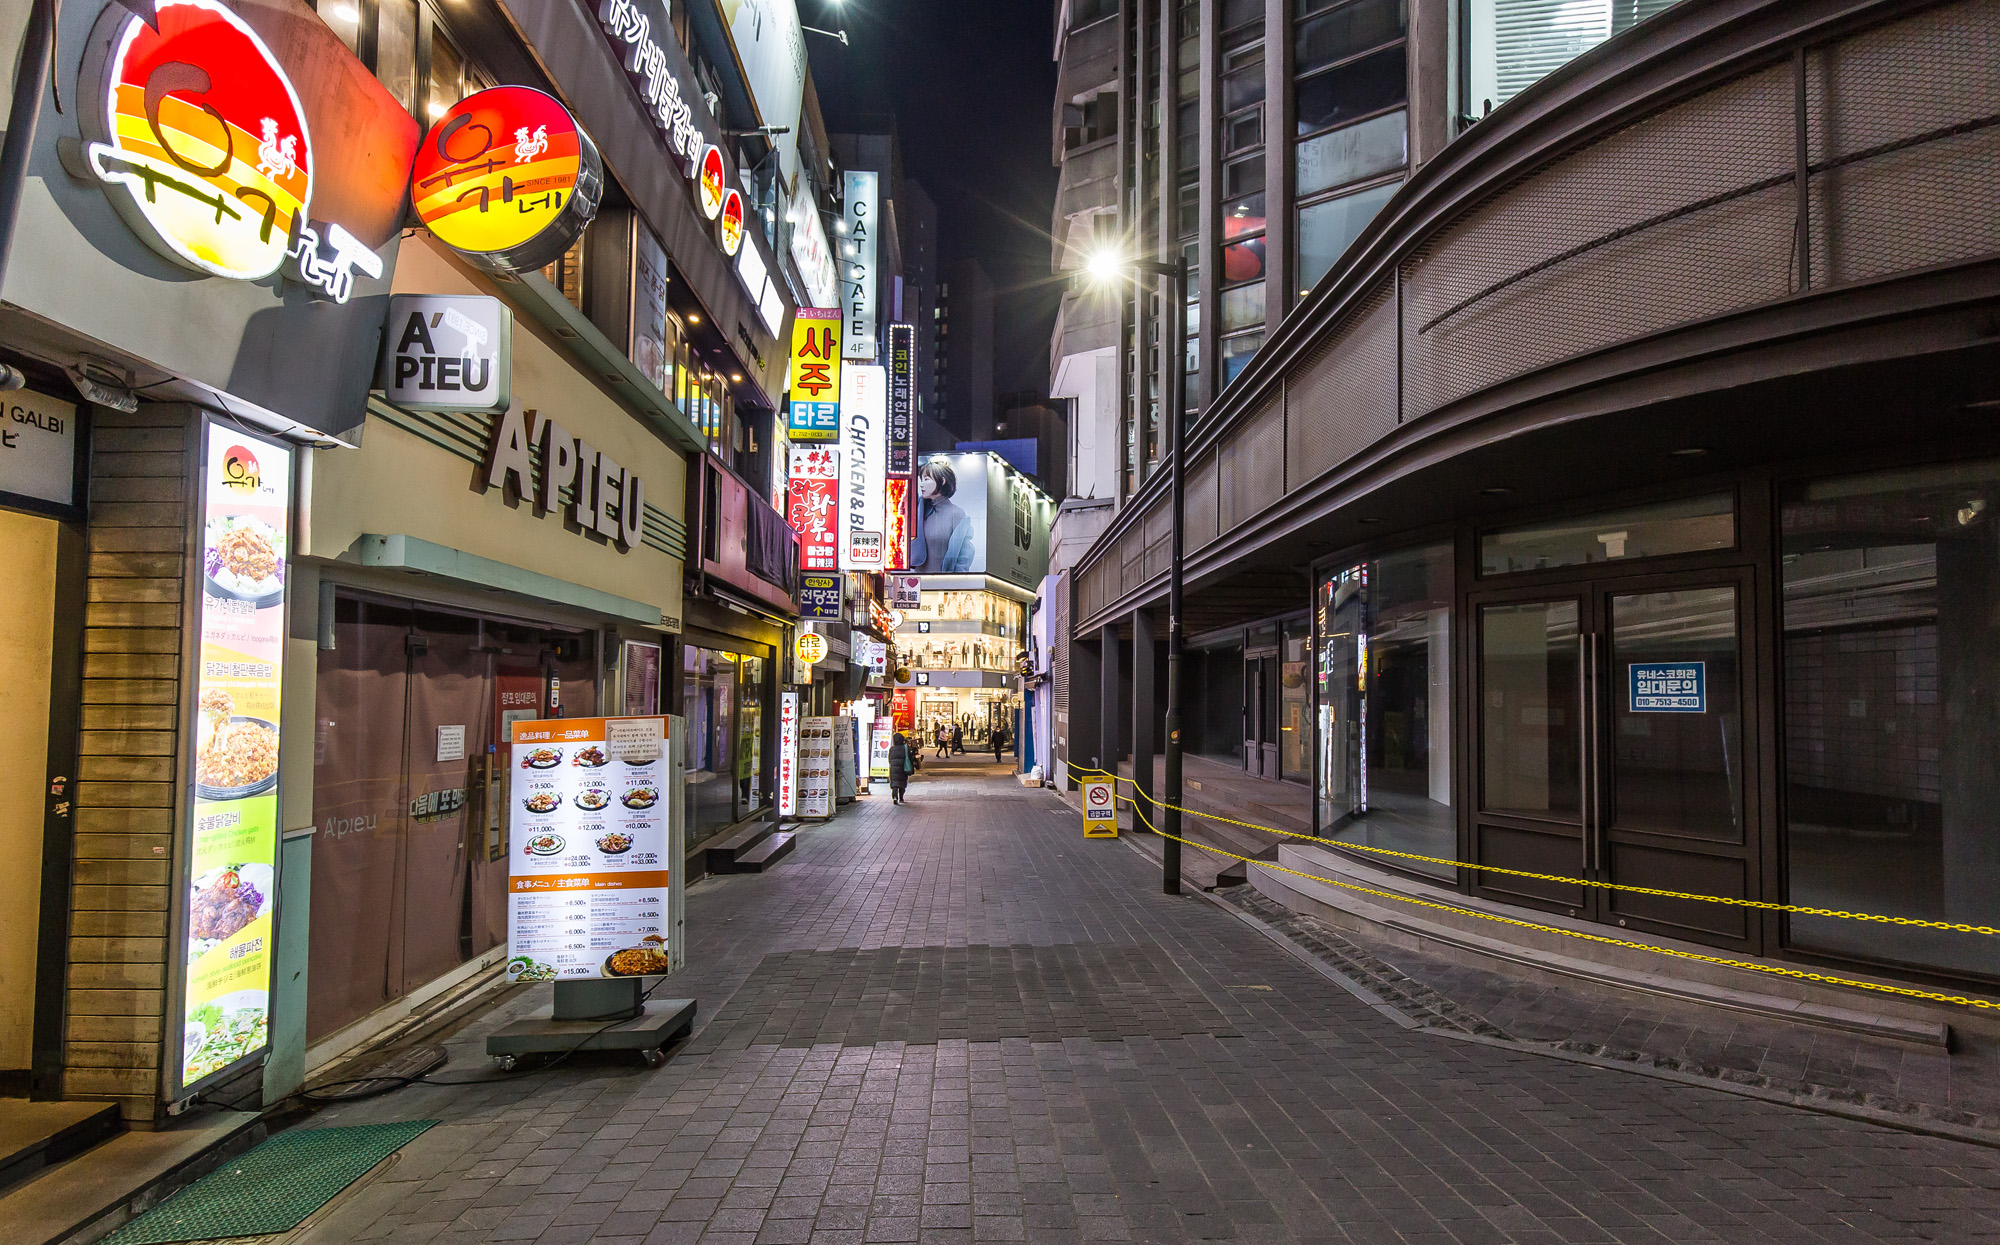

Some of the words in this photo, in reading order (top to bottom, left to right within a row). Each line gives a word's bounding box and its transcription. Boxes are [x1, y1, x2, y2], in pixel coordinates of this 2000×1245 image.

[420, 112, 562, 214] 유가네
[98, 61, 350, 299] 유가네
[526, 178, 551, 187] SINCE
[553, 175, 572, 184] 1981
[852, 201, 867, 254] CAT
[851, 264, 866, 336] CAFE
[850, 343, 864, 353] 4F
[798, 327, 837, 396] 사주
[395, 356, 489, 392] PIEU
[893, 349, 908, 440] 코인노래연습장
[11, 406, 65, 435] GALBI
[794, 403, 836, 427] 타로
[850, 414, 870, 497] CHICKEN
[893, 450, 908, 460] 3F
[222, 456, 275, 494] 유가네
[489, 396, 645, 549] A'PIEU
[850, 496, 865, 510] &
[852, 548, 879, 558] 마라탕
[807, 579, 831, 588] 한양사
[204, 596, 257, 616] 유가네닭갈비
[800, 589, 839, 605] 전당포
[799, 637, 820, 648] 타로
[799, 648, 821, 660] 사주
[205, 662, 273, 678] 닭갈비철판볶음밥
[1637, 669, 1697, 679] 유네스코회관
[1637, 680, 1698, 694] 임대문의
[502, 692, 514, 705] 점포
[1637, 698, 1697, 706] 010-7513-4500
[409, 791, 439, 816] 다음에
[440, 789, 450, 810] 또
[198, 811, 241, 832] 숯불닭갈비
[229, 936, 263, 960] 해물파전
